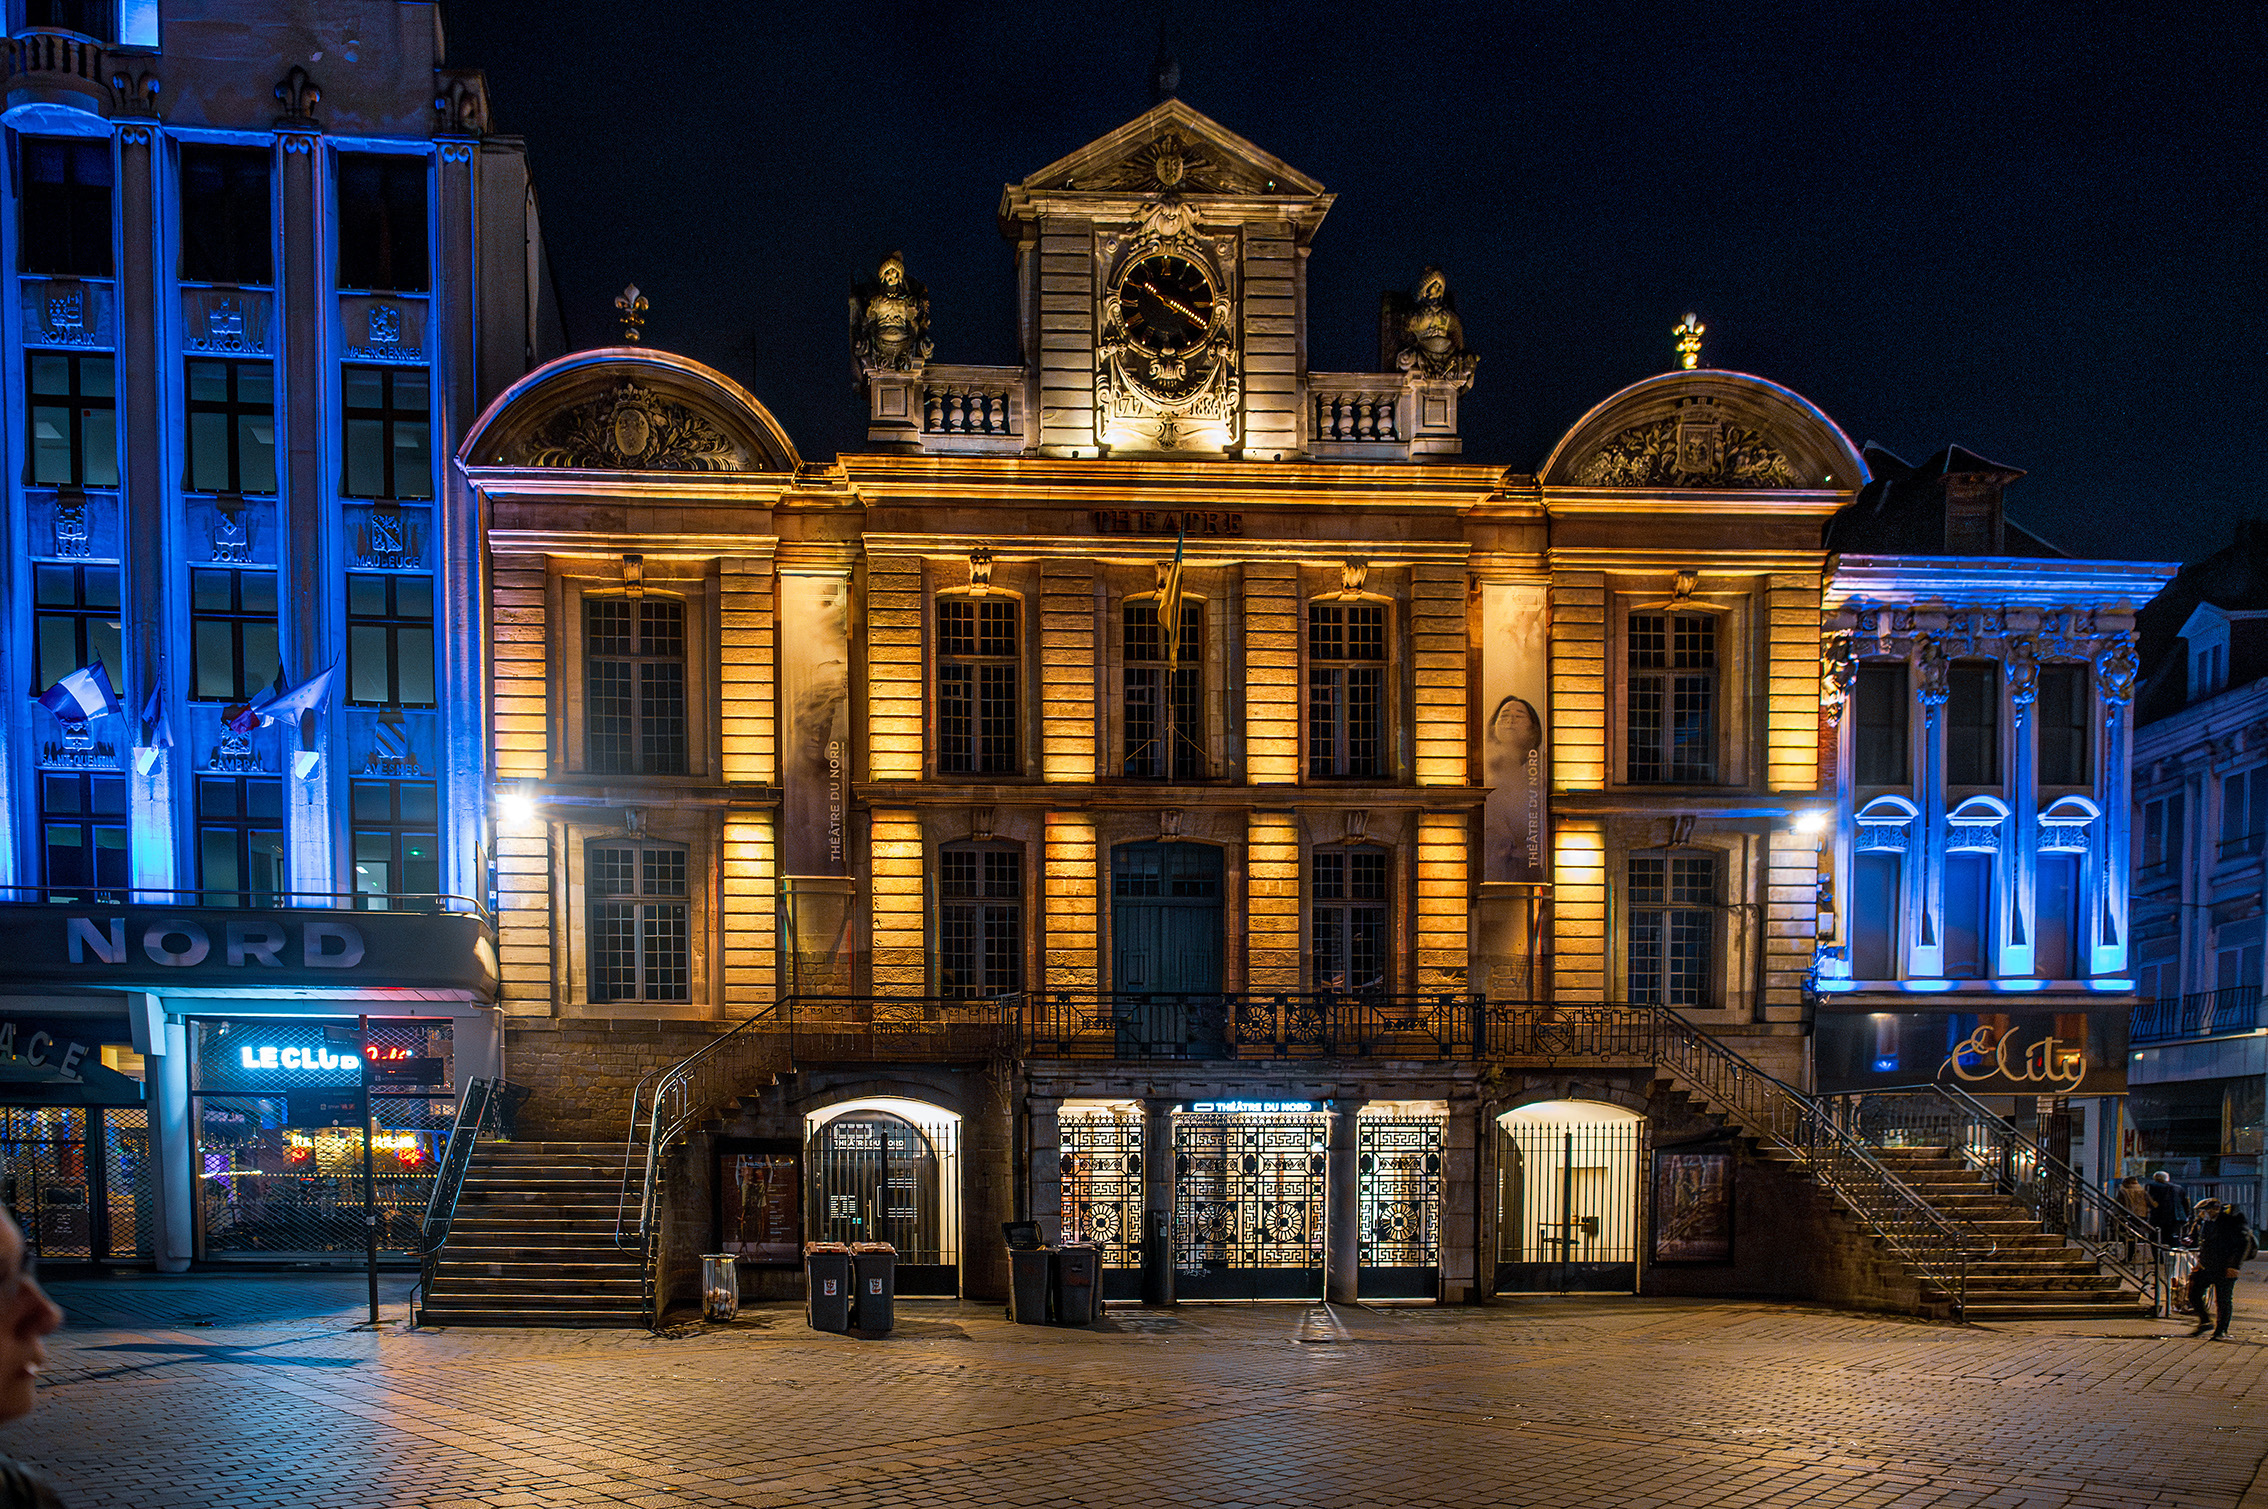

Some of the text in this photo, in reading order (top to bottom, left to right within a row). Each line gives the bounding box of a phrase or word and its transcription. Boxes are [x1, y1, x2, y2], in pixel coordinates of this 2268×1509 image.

[207, 758, 264, 772] CAMBRAI
[828, 740, 841, 862] THÉÂTRE DU NORD
[1526, 749, 1538, 868] THÉÂTRE DU NORD
[66, 917, 366, 968] NORD
[1216, 1101, 1311, 1111] THÉÂTRE DU NORD
[885, 1139, 905, 1147] ORD
